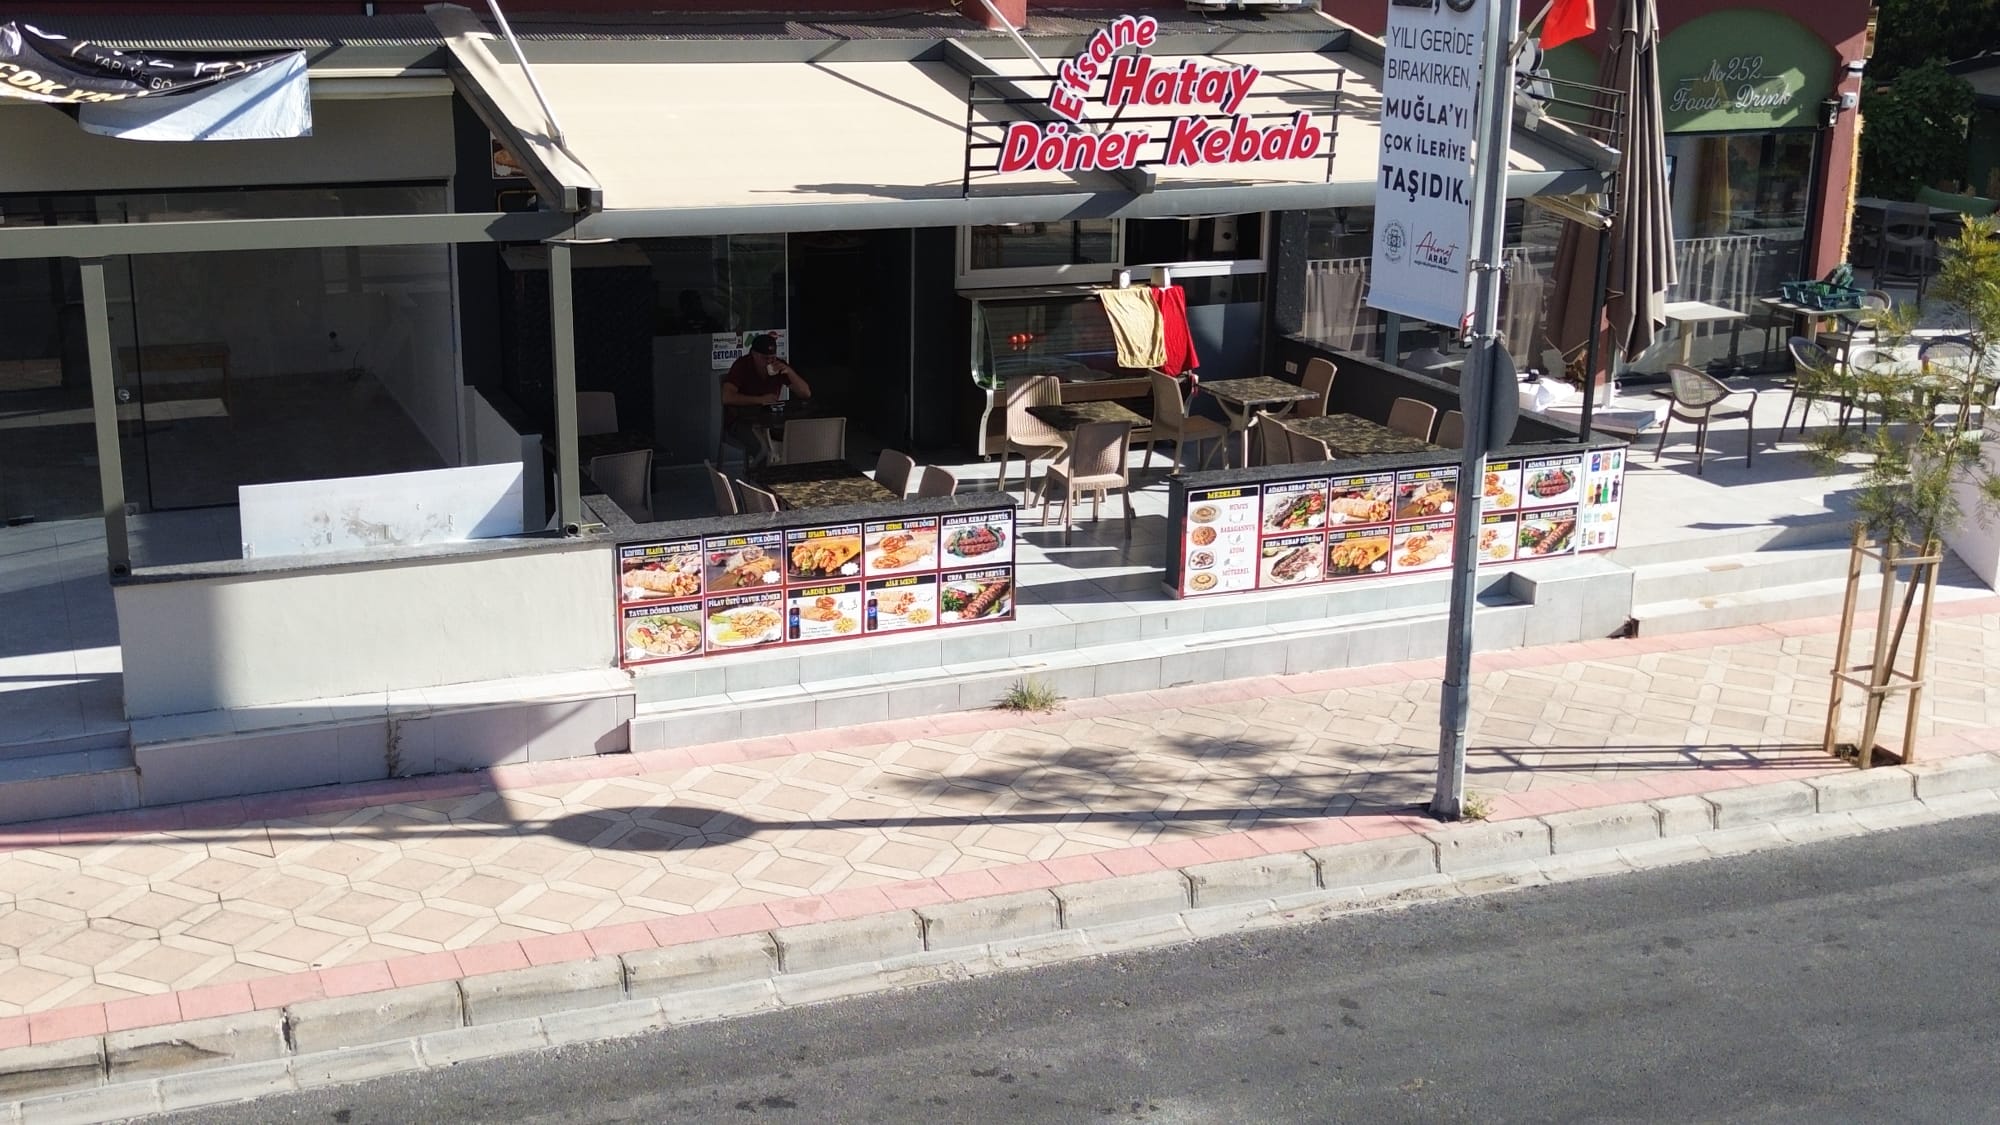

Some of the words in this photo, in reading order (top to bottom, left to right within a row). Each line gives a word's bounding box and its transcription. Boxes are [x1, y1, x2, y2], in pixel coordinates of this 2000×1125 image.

[1391, 26, 1417, 49] YILI
[1420, 27, 1474, 56] GERİDE
[1052, 16, 1156, 123] Efsane
[1106, 56, 1261, 115] Hatay
[1388, 58, 1471, 92] BIRAKIRKEN,
[1726, 56, 1763, 81] 252
[1385, 94, 1468, 130] MUĞLA'YI
[1669, 87, 1721, 112] Food
[1735, 83, 1792, 109] Drink
[1000, 122, 1149, 173] Döner
[1166, 111, 1322, 168] Kebab
[1384, 133, 1412, 154] ÇOK
[1416, 133, 1466, 162] İLERİYE
[1382, 164, 1469, 206] TAŞIDIK.
[1428, 253, 1448, 266] ARAS
